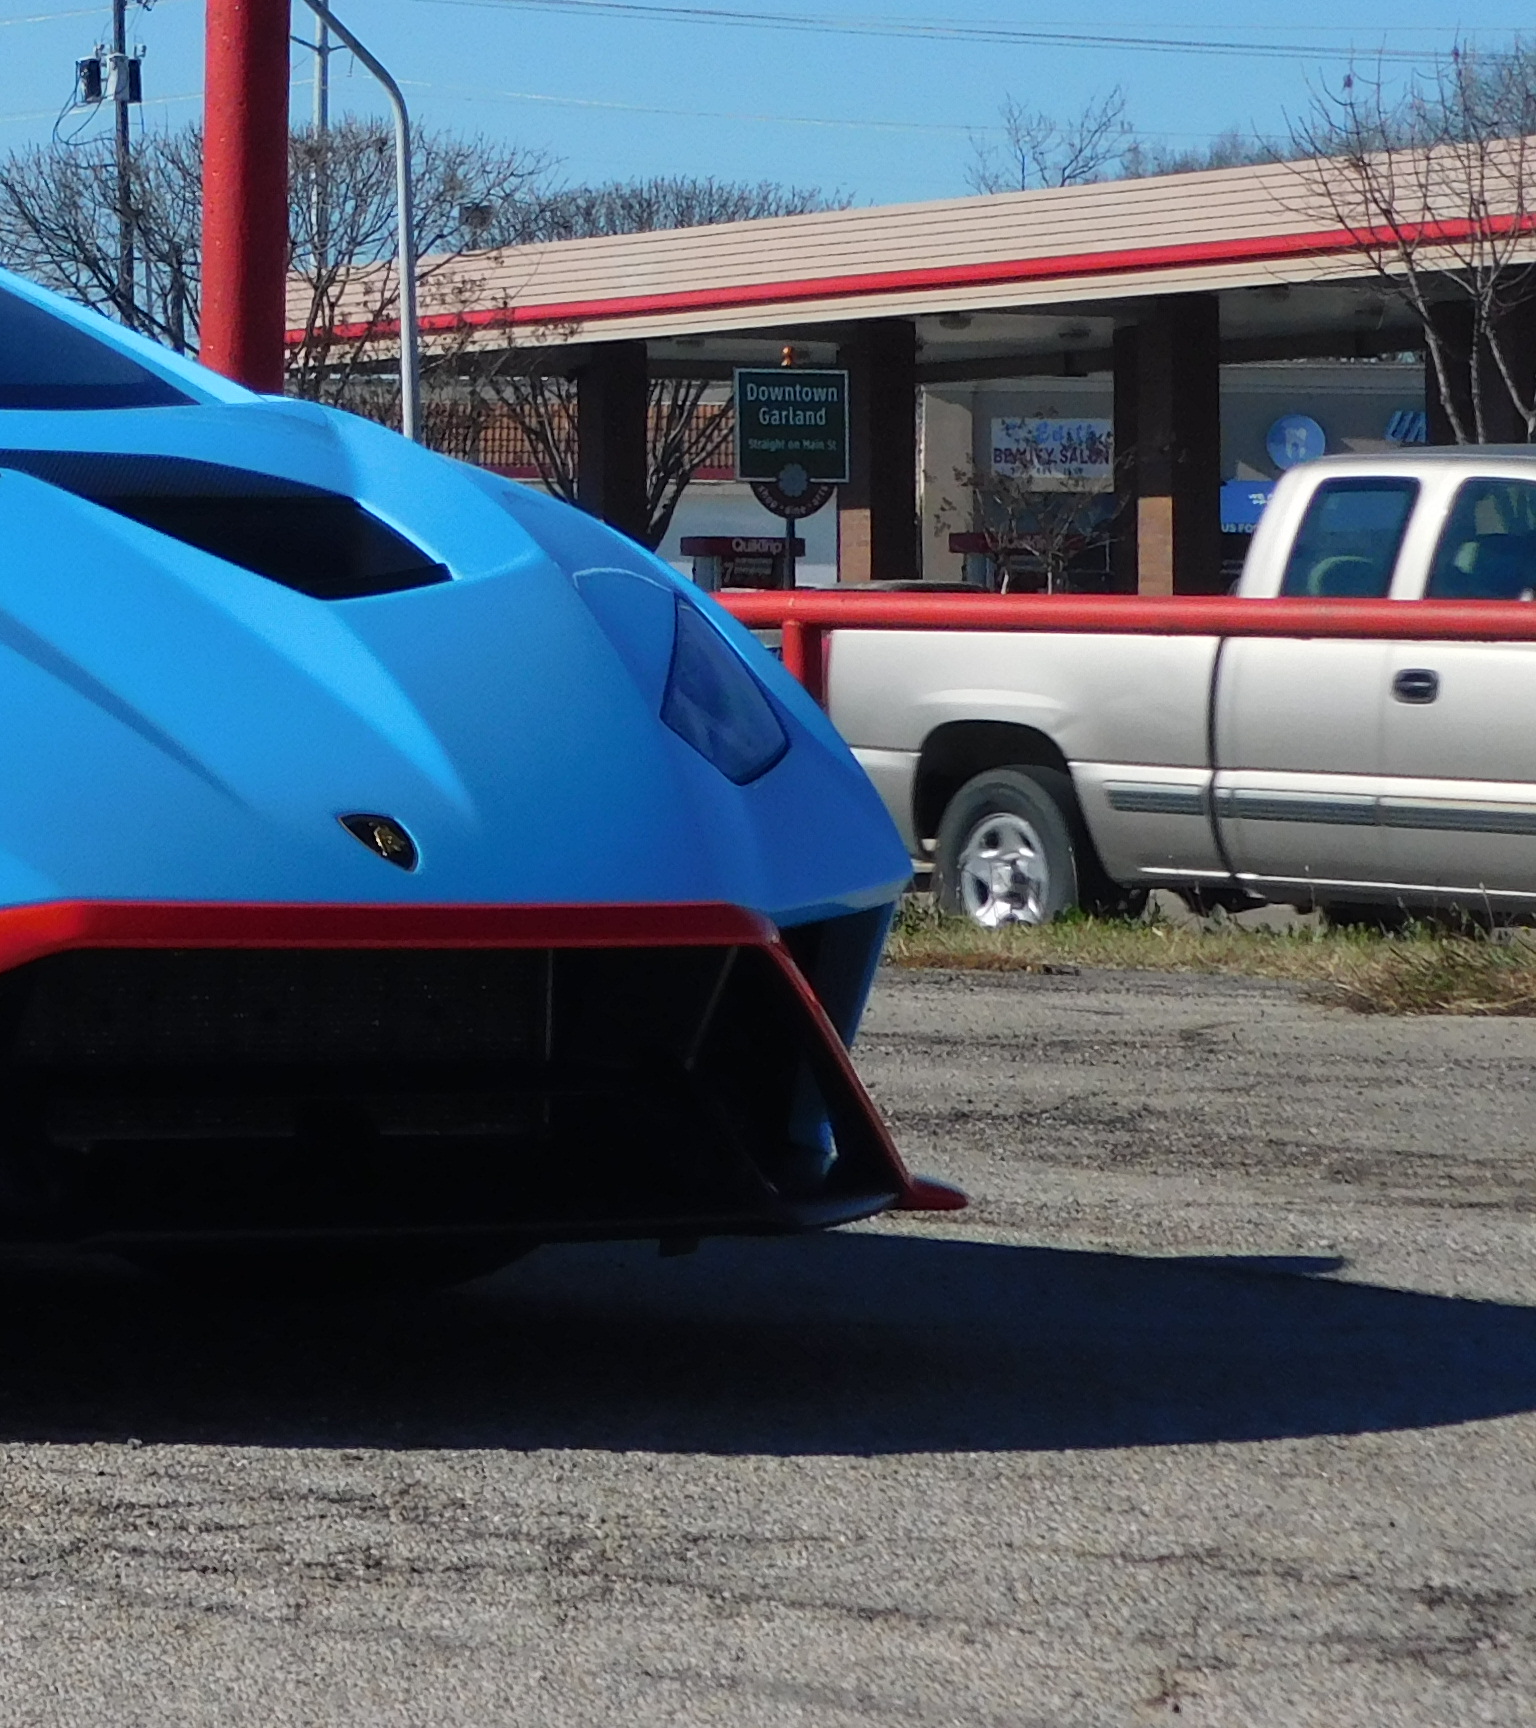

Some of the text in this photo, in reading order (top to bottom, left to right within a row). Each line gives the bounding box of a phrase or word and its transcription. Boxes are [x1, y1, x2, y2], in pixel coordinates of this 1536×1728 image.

[747, 384, 838, 402] Downtown
[759, 407, 826, 426] Garland
[748, 438, 838, 451] Straight on Main St
[732, 538, 782, 556] QuikTrip
